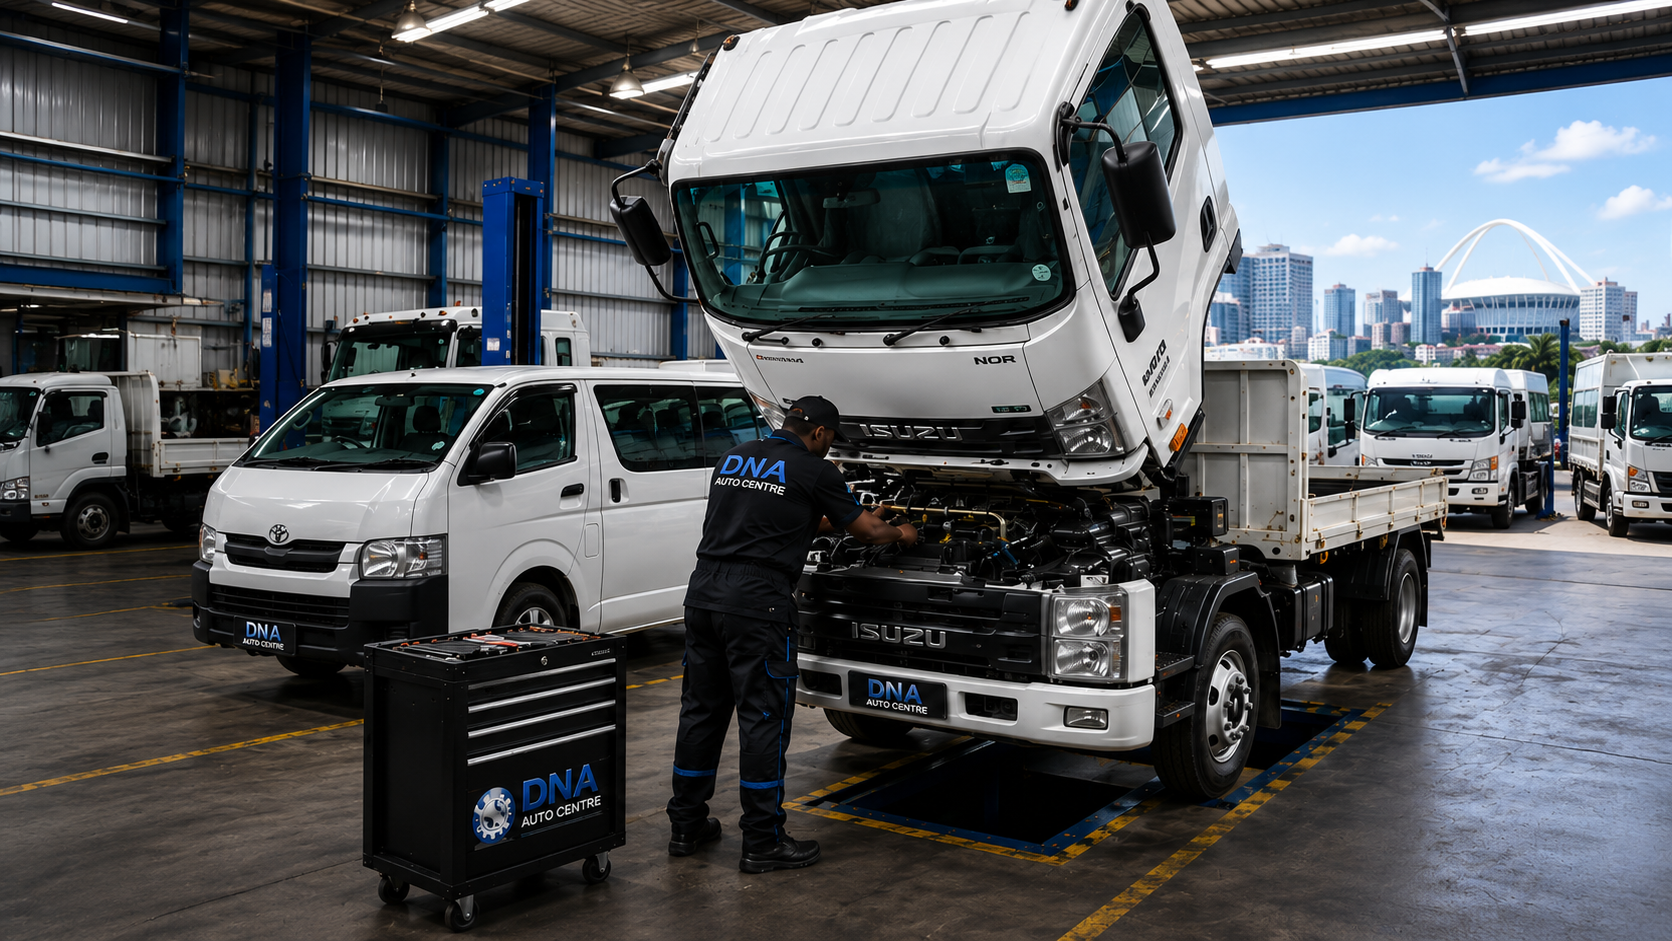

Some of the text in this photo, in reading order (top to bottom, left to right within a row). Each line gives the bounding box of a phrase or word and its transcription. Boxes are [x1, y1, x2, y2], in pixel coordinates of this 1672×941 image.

[973, 355, 1017, 366] NOR
[859, 423, 963, 441] ISUZU
[720, 454, 787, 484] DNA
[714, 477, 787, 496] AUTO CENTRE
[242, 637, 260, 647] AUTO
[246, 620, 282, 642] DNA
[851, 621, 947, 649] ISUZU
[868, 678, 923, 705] DNA
[866, 698, 928, 715] AUTO CENTRE
[522, 763, 599, 812] DNA
[521, 795, 602, 828] AUTO CENTRE
